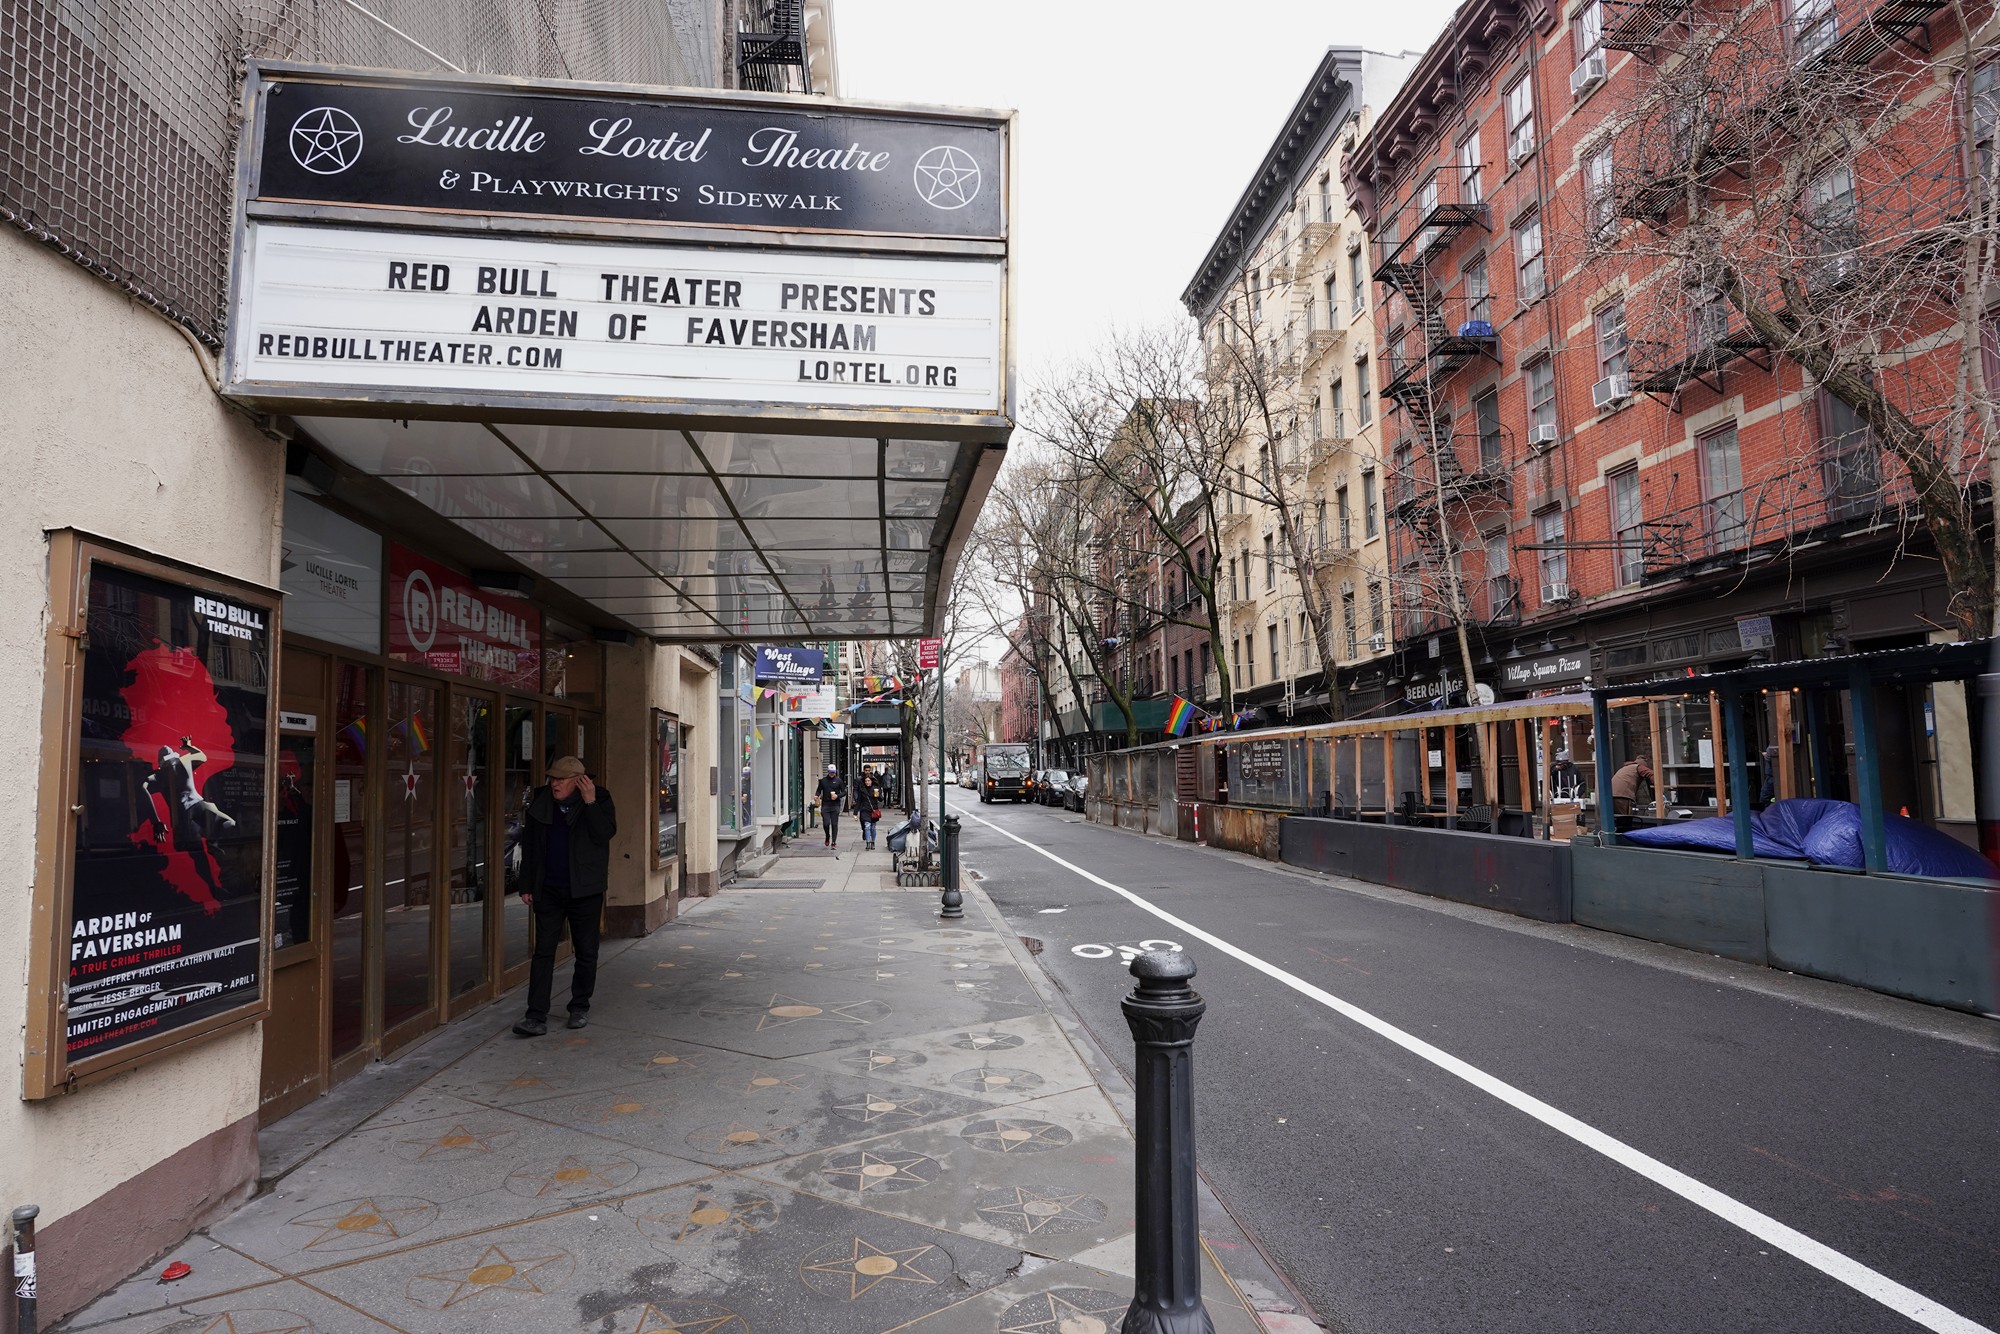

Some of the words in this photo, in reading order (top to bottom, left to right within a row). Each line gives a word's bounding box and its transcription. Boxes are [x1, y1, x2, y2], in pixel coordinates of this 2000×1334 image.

[397, 106, 546, 153] Lucille
[578, 117, 713, 162] Lortel
[741, 126, 892, 172] Theatre
[438, 169, 461, 190] &
[698, 184, 843, 211] SIDEWALK
[388, 261, 450, 291] RED
[476, 266, 557, 297] BULL
[601, 273, 742, 308] THEATER
[781, 282, 936, 316] PRESENTS
[472, 305, 578, 338] ARDEN
[608, 313, 647, 341] OF
[687, 317, 876, 351] FAVERSHAM
[258, 333, 562, 369] REDBULLTHEATER.COM
[799, 359, 957, 387] LORTEL.ORG
[306, 561, 333, 581] LUCILLE
[334, 572, 358, 591] LORTEL
[319, 579, 346, 599] THEATRE
[194, 595, 227, 619] RED
[228, 605, 264, 630] BULL
[440, 586, 485, 632] RED
[486, 605, 530, 649] BULL
[207, 619, 252, 641] THEATER
[458, 635, 517, 673] THEATER
[764, 648, 792, 661] West
[776, 661, 815, 677] Village
[1507, 665, 1531, 682] Village
[1533, 662, 1557, 680] Square
[1558, 658, 1581, 673] Pizza
[1406, 685, 1427, 700] BEER
[287, 716, 307, 725] THEATRE
[72, 912, 137, 938] ARDEN
[139, 912, 152, 923] OF
[71, 924, 182, 961] FAVERSHAM
[70, 967, 77, 977] A
[81, 960, 108, 974] TRUE
[110, 953, 141, 968] CRIME
[143, 944, 182, 961] THRILLER
[100, 971, 137, 987] JEFFREY
[139, 962, 175, 977] HATCHER
[179, 953, 212, 968] KATHRYN
[213, 946, 236, 959] WALAT
[67, 1015, 112, 1037] LIMITED
[114, 996, 179, 1023] ENGAGEMENT
[186, 985, 216, 1002] MARCH
[217, 983, 223, 993] 6
[230, 974, 250, 989] APRIL
[251, 973, 255, 982] 1
[101, 990, 127, 1005] JESSE
[129, 981, 161, 997] BERGER
[66, 1017, 158, 1052] REDBULLTHEATER.COM
